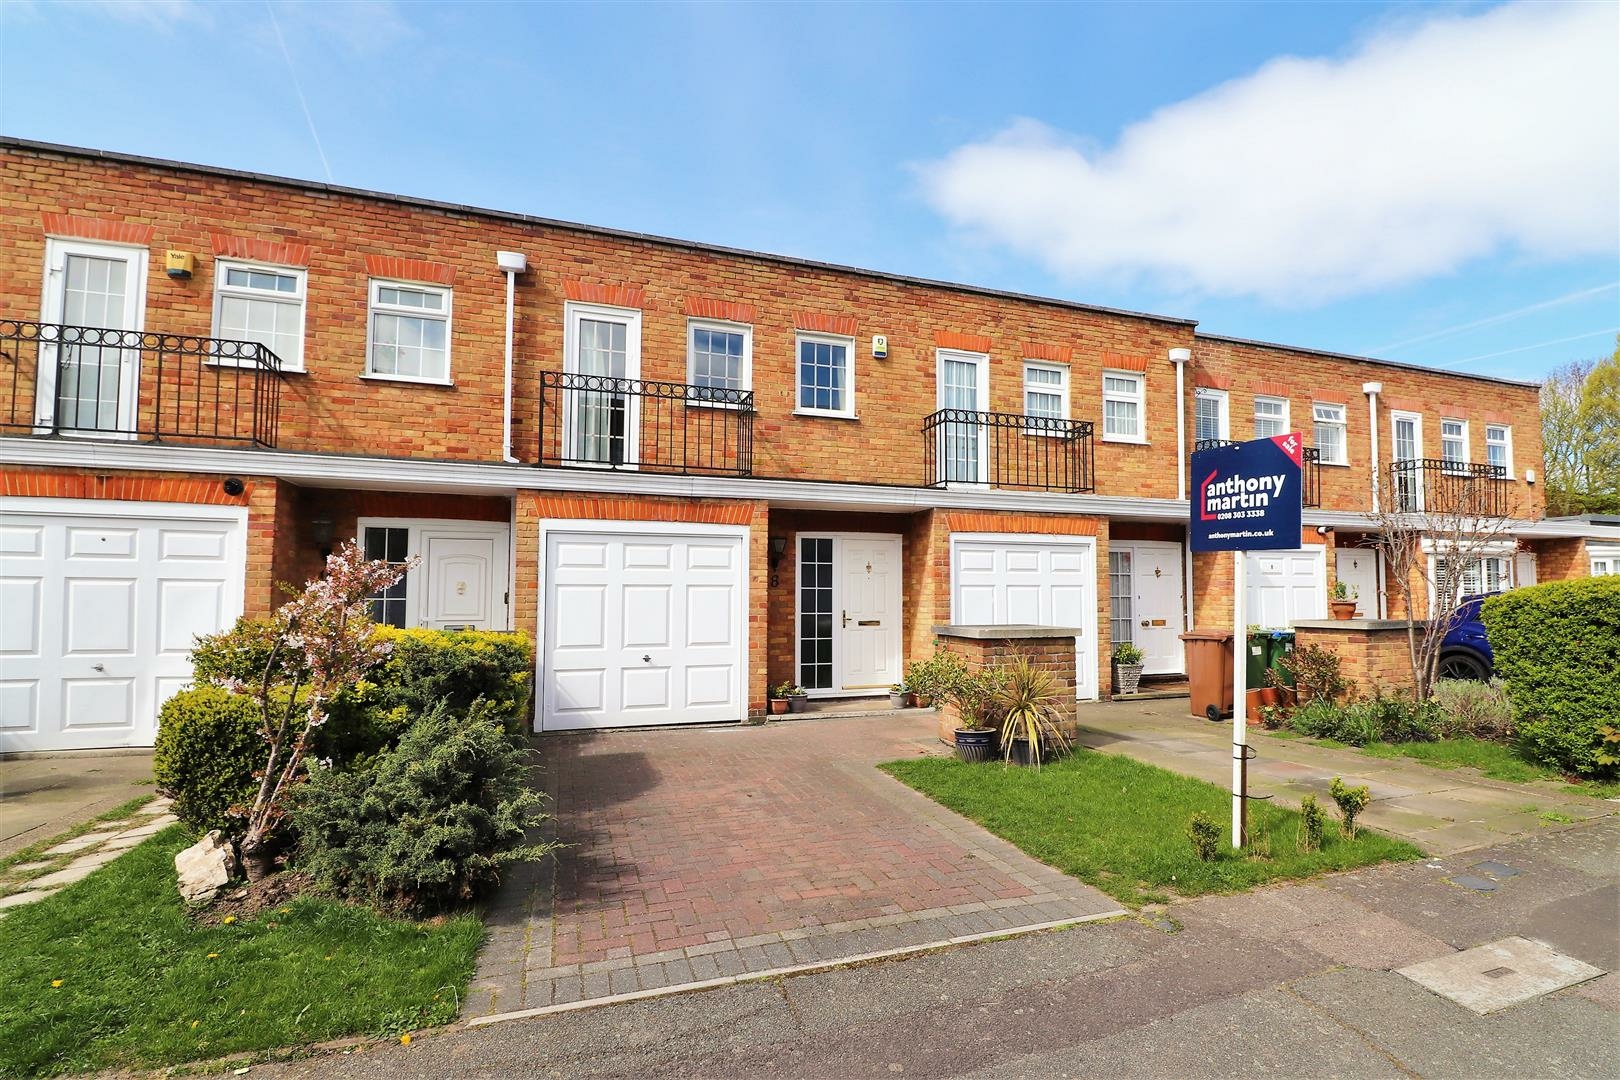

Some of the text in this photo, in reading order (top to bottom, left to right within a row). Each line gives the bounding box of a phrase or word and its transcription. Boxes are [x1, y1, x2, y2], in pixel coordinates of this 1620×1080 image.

[1282, 441, 1294, 454] sale
[1288, 436, 1298, 446] for
[1207, 474, 1286, 497] anthony
[1207, 492, 1268, 511] martin
[1208, 529, 1274, 539] anthonymartin.co.uk
